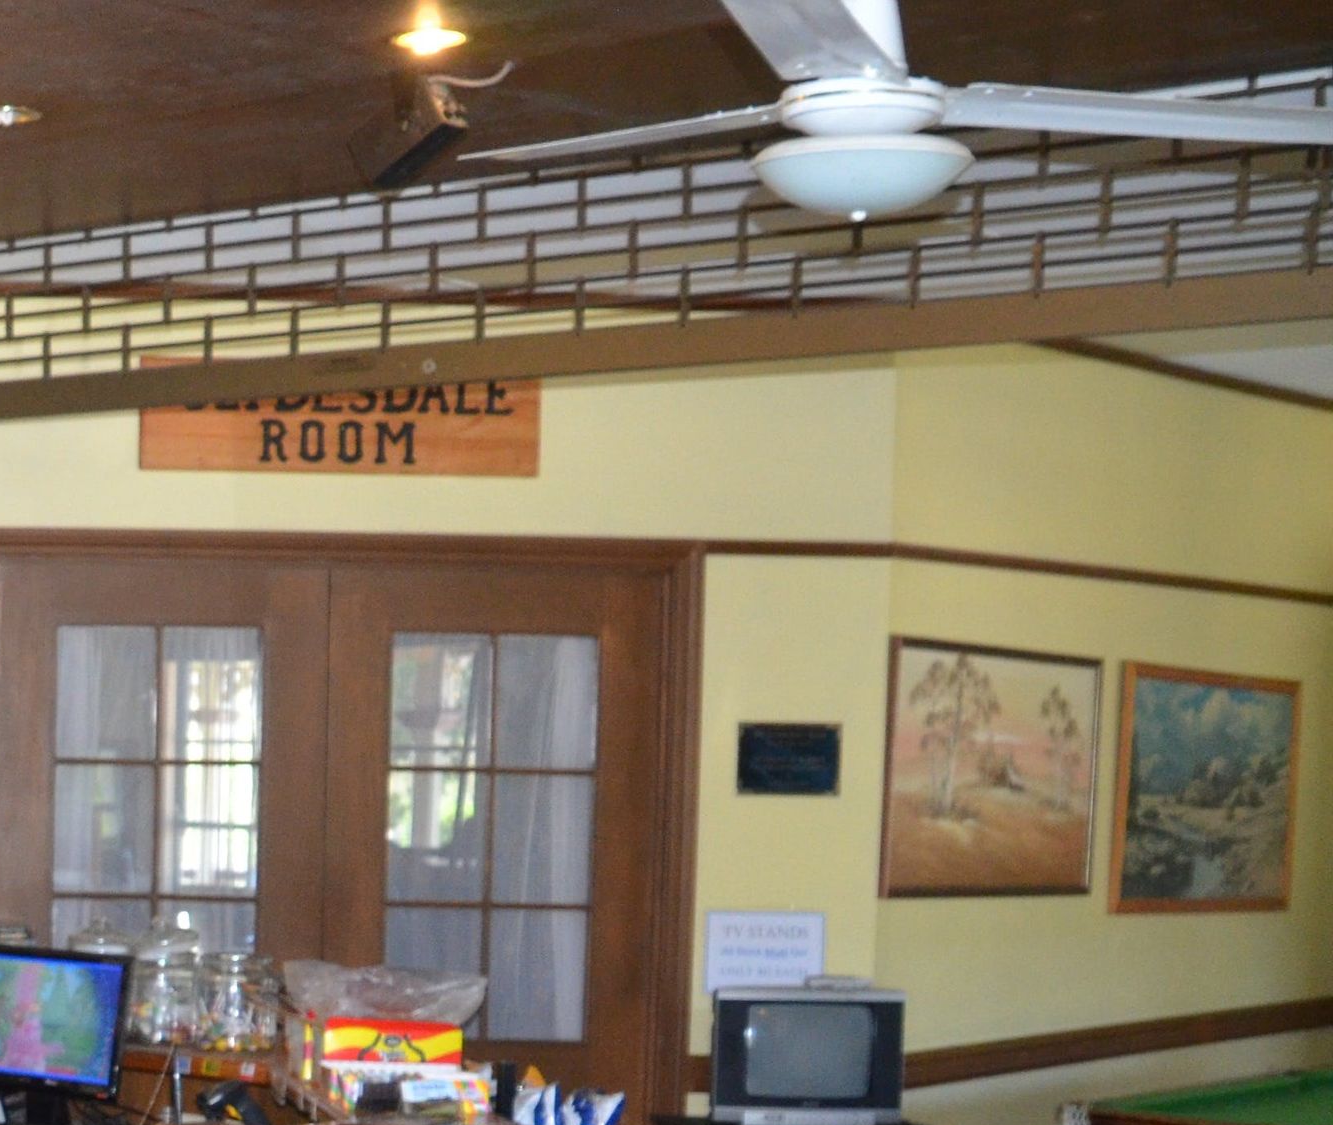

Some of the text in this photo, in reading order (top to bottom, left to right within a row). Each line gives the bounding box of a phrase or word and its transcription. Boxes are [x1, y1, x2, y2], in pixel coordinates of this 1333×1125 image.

[185, 379, 515, 416] SDALE
[260, 418, 416, 465] ROOM
[724, 925, 809, 937] TV STANDS
